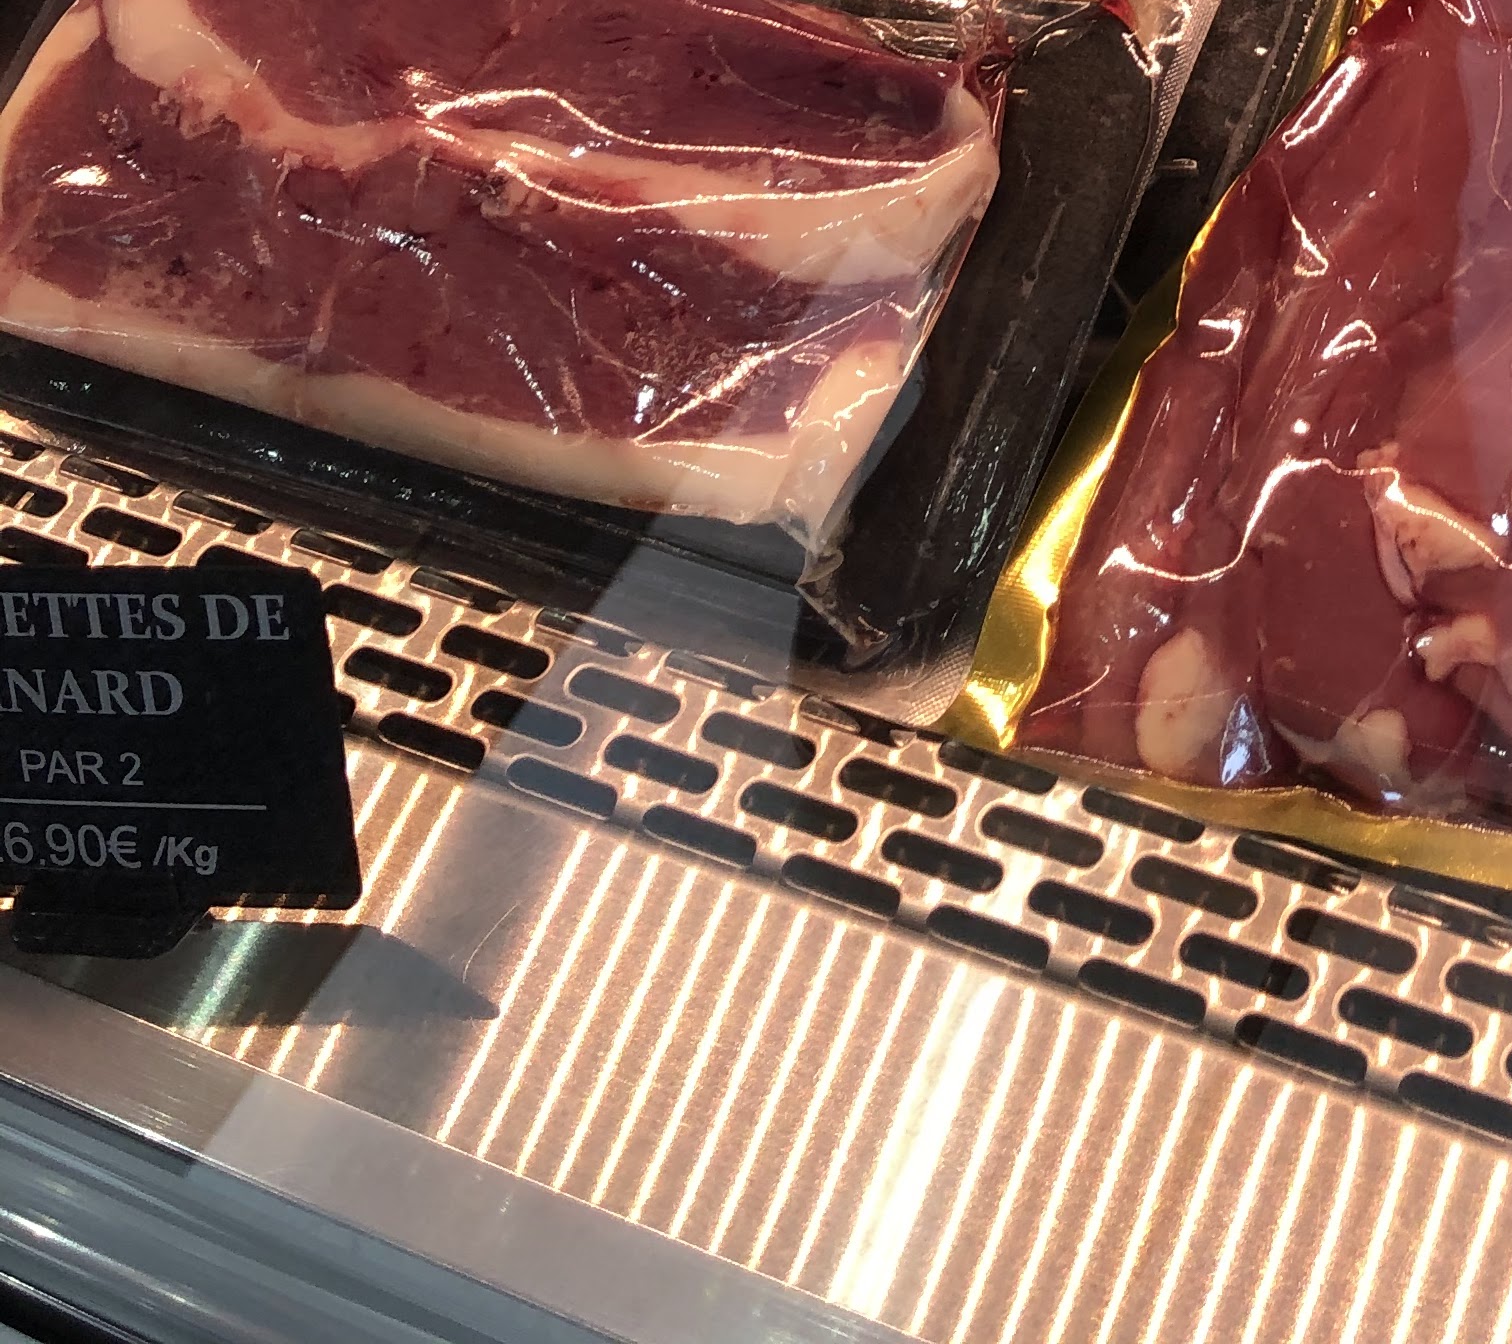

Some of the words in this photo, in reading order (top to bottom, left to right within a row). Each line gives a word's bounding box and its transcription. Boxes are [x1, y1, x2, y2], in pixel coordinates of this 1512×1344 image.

[0, 592, 187, 641] ETTES
[199, 594, 290, 641] DE
[0, 668, 184, 716] NARD
[19, 749, 109, 786] PAR
[119, 752, 145, 786] 2
[0, 821, 142, 869] 6.90€
[152, 835, 219, 876] /Kg
